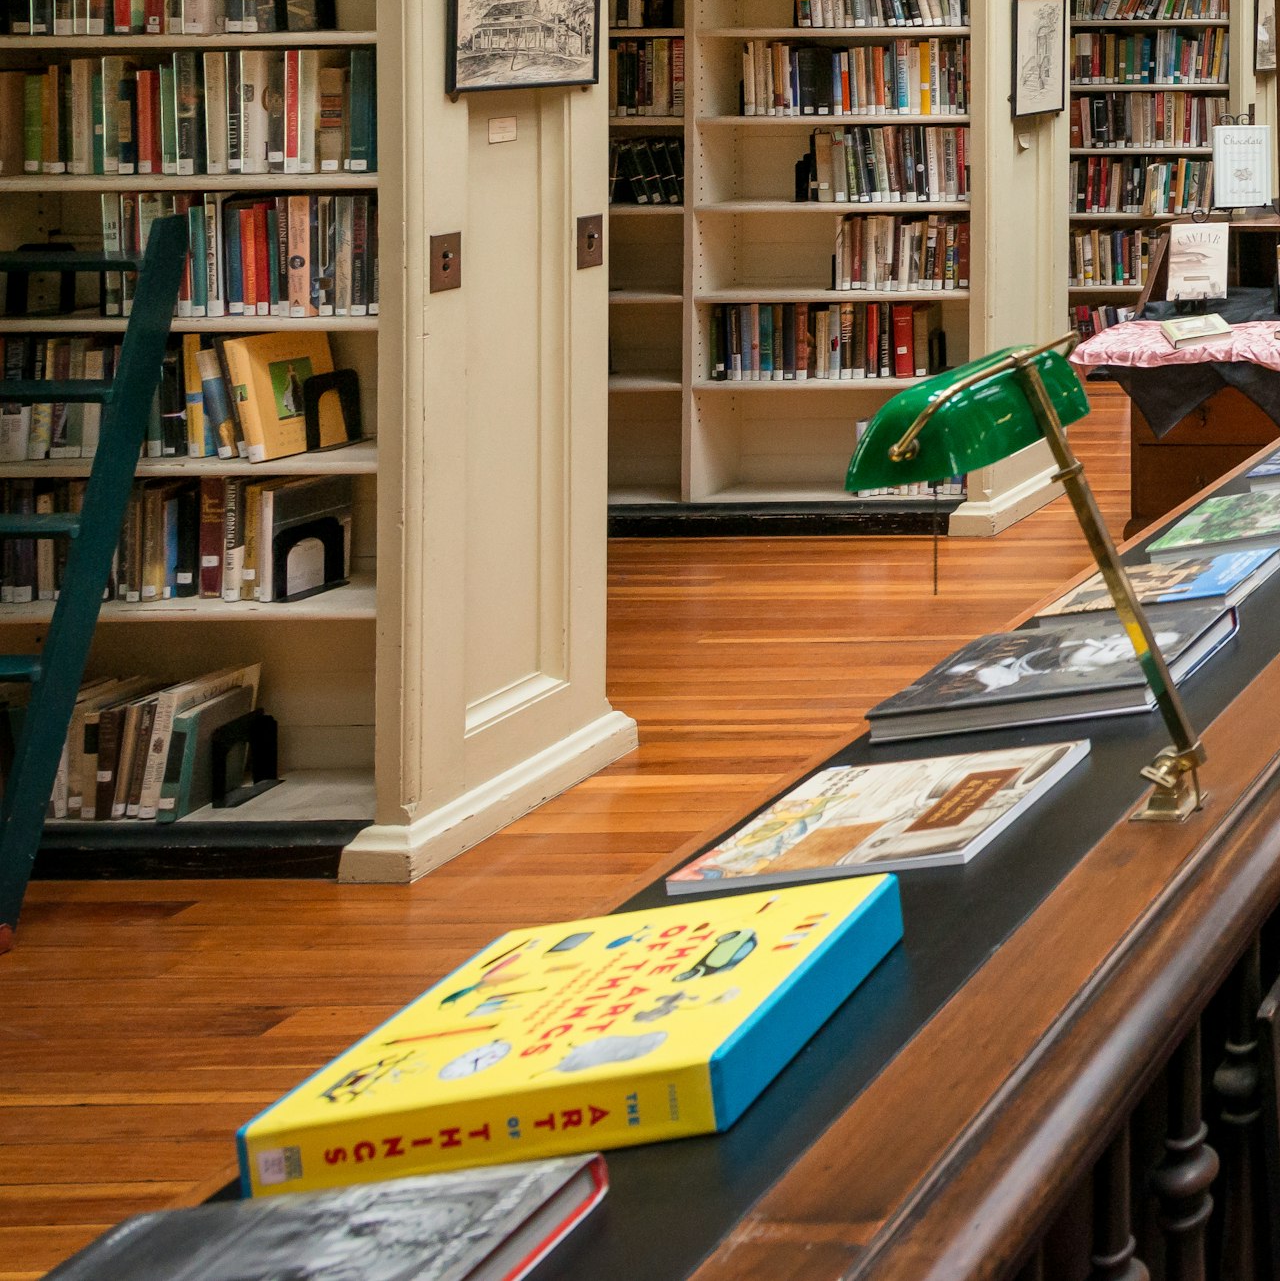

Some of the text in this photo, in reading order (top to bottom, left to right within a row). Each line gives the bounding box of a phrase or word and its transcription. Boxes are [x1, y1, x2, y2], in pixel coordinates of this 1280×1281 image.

[1223, 134, 1264, 146] Chocolate
[1176, 232, 1222, 246] CAVIAR
[841, 321, 852, 343] Alibi
[644, 923, 690, 956] OF
[653, 930, 718, 976] THE
[519, 959, 646, 1060] THINGS
[583, 984, 651, 1036] ART
[533, 1104, 611, 1133] ART
[625, 1093, 641, 1127] THE
[323, 1122, 491, 1168] THINGS
[507, 1117, 522, 1140] OF
